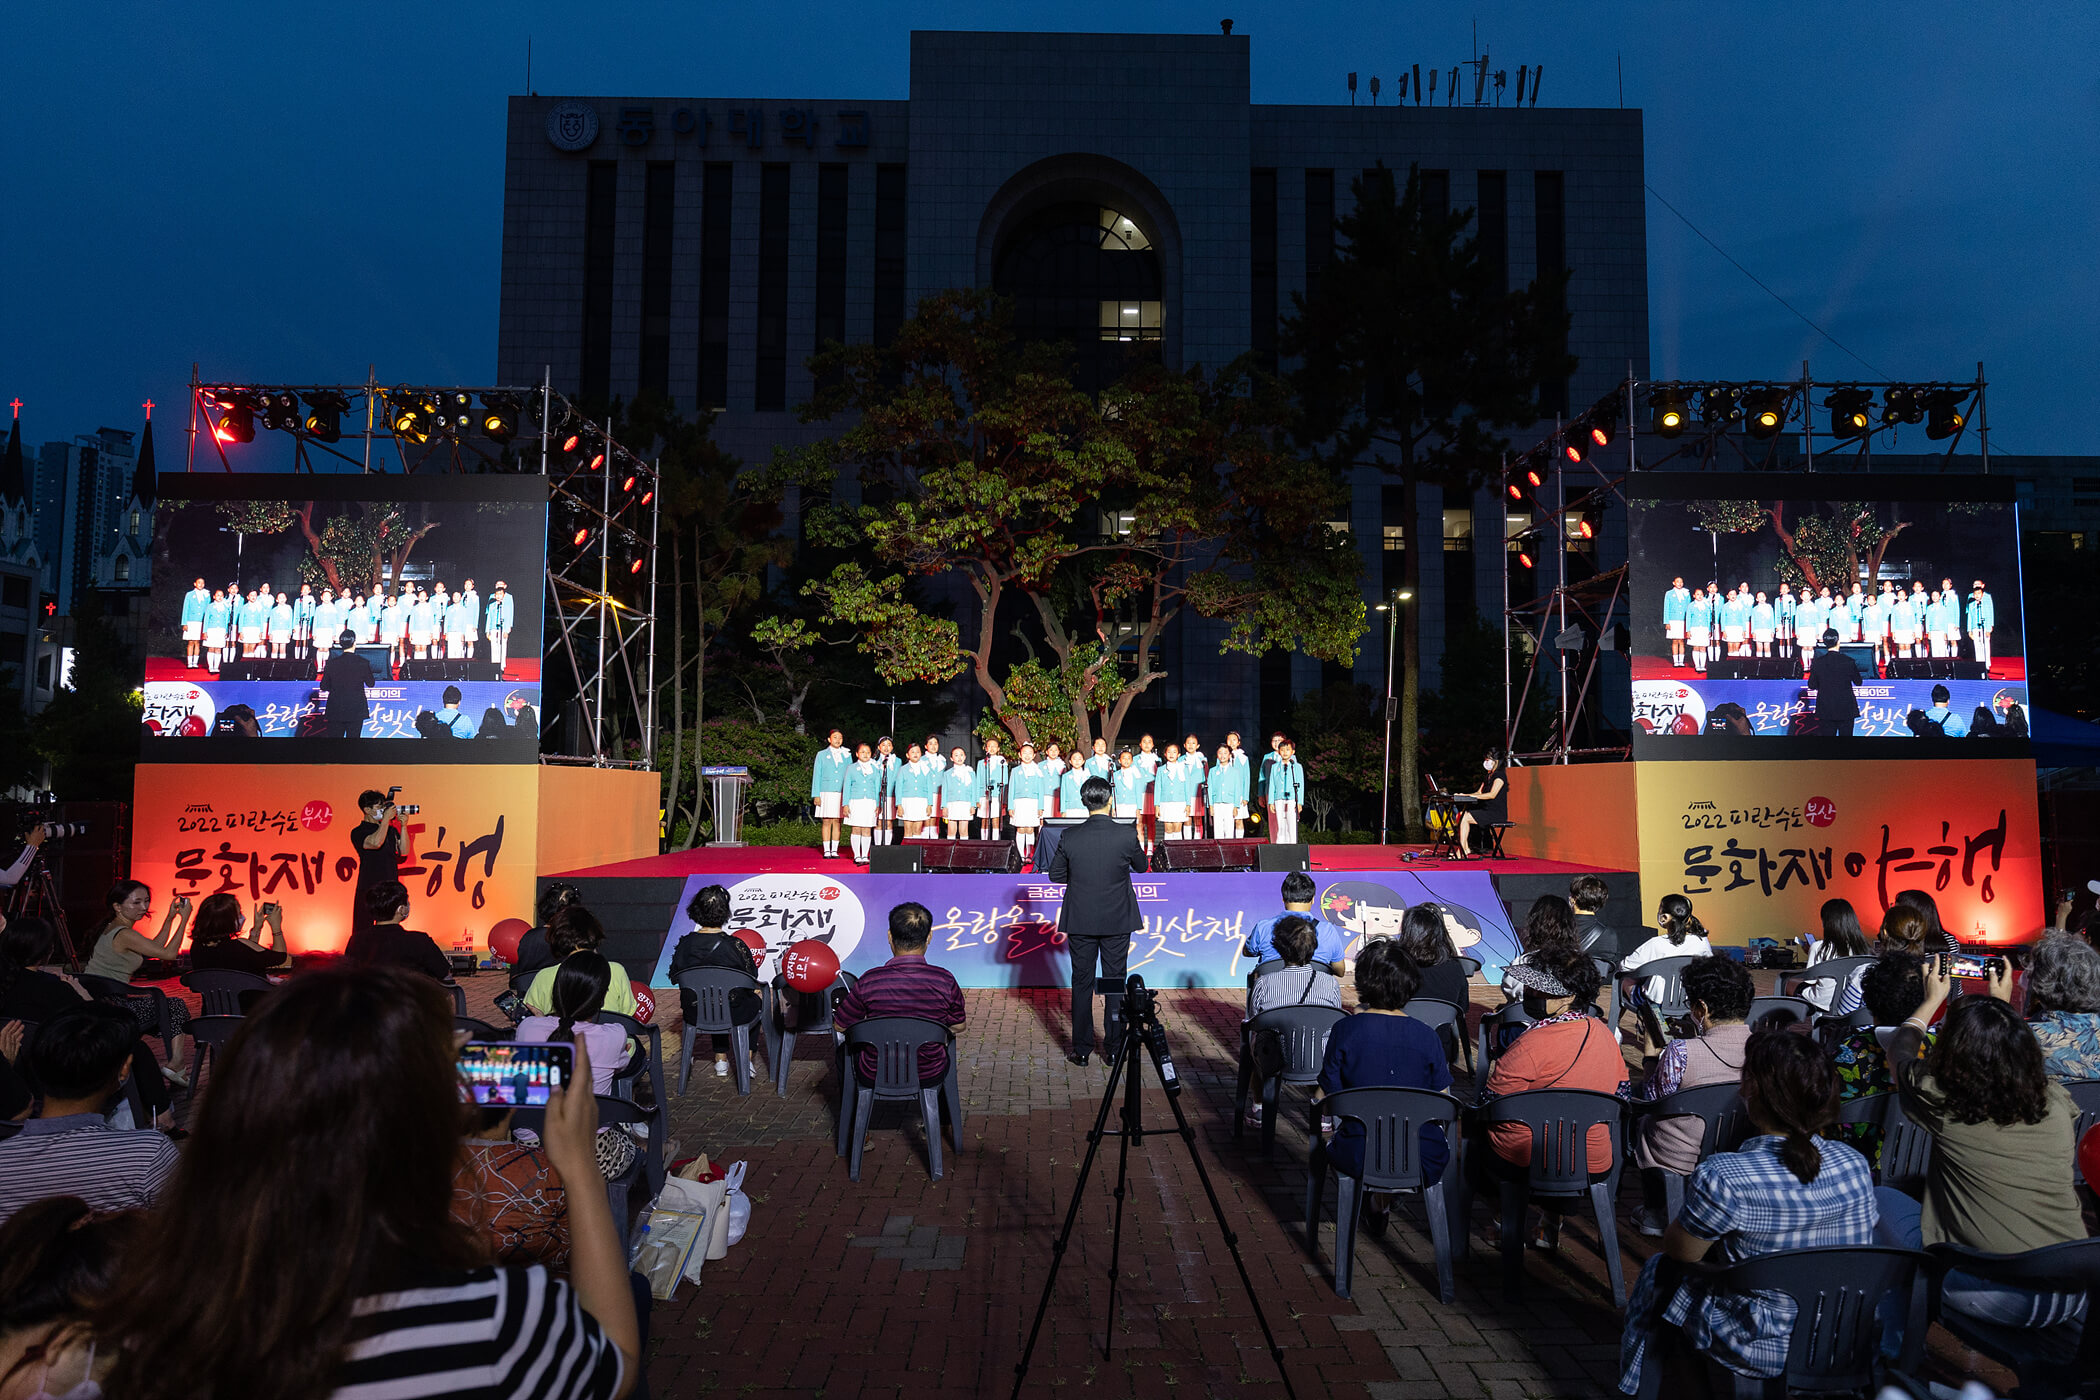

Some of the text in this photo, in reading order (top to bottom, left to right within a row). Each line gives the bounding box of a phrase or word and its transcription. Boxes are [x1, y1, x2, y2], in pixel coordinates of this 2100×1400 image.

[616, 106, 869, 148] 동아대학교
[177, 806, 333, 836] 2022 피란수도 부산
[1681, 801, 1837, 832] 2022 피란수도 부산
[172, 841, 326, 901] 문화재
[1683, 808, 2007, 913] 문화재 야행
[738, 886, 841, 902] 2022 피란수도 부산
[727, 904, 834, 931] 문화재
